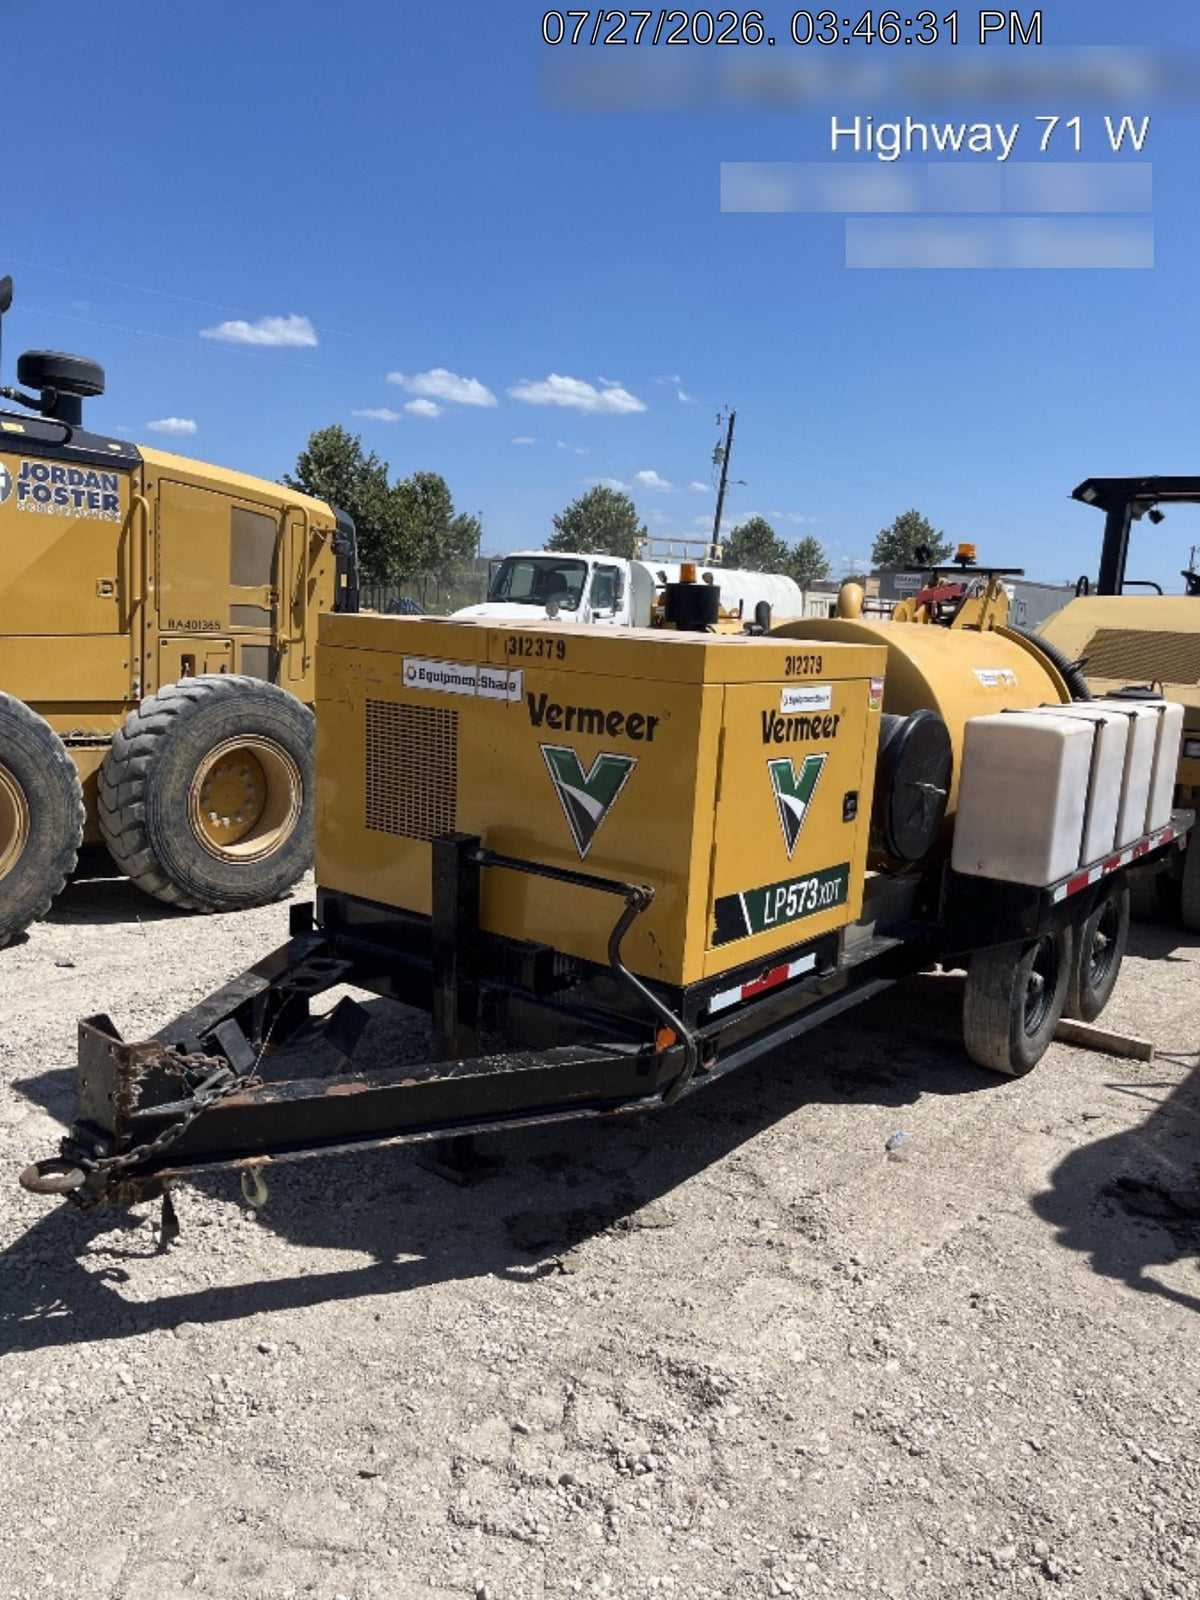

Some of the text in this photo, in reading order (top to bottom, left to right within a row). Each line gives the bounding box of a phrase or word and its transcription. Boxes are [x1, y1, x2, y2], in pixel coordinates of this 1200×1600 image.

[18, 461, 118, 492] JORDAN
[17, 482, 120, 512] FOSTER
[509, 636, 566, 660] 312379
[418, 667, 517, 692] EquipmenShare
[785, 655, 823, 676] 312379
[527, 692, 660, 742] Vermeer
[762, 710, 840, 744] Vermeer
